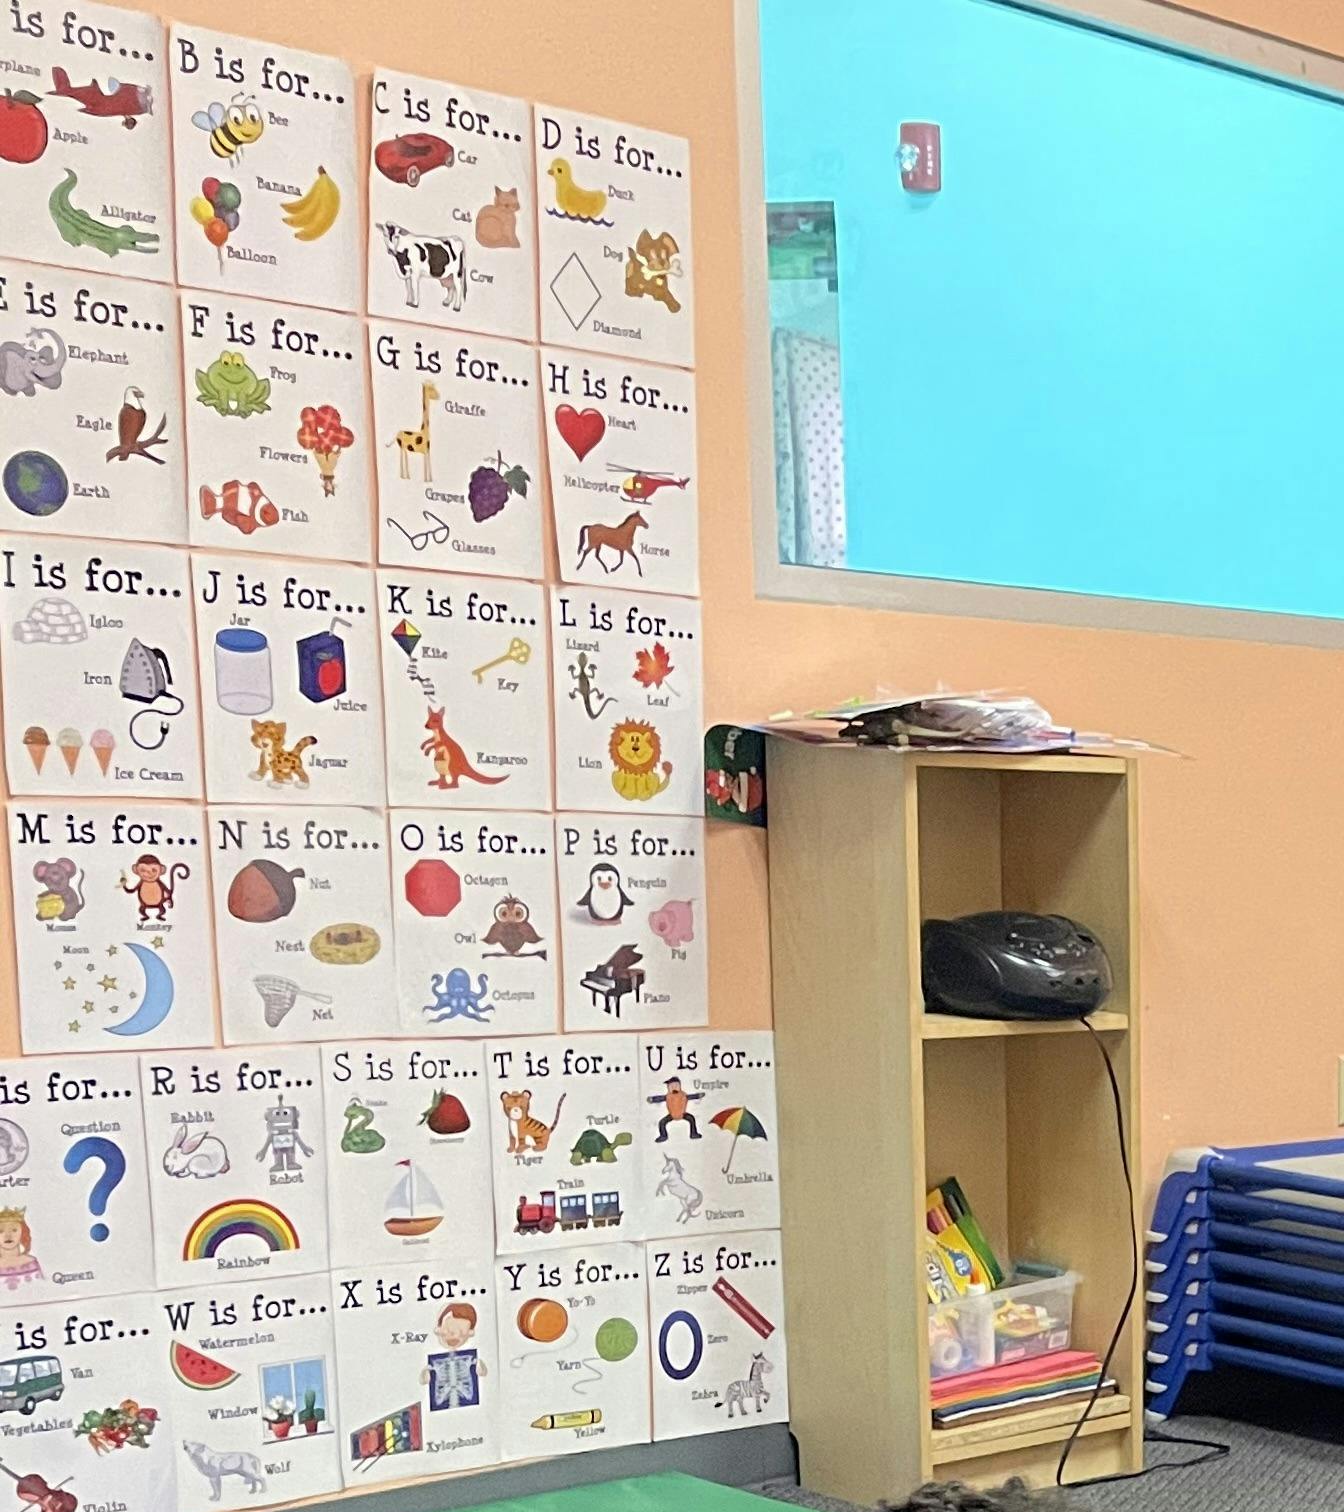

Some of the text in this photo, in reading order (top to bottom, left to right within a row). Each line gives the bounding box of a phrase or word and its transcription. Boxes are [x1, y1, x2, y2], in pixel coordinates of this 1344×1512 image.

[10, 0, 154, 61] is for...
[178, 38, 345, 104] B is for...
[375, 81, 522, 143] C is for...
[52, 128, 88, 144] Apple
[542, 117, 682, 178] D is for...
[101, 205, 156, 224] Alligator
[227, 246, 278, 265] Balloon
[24, 281, 56, 317] is
[74, 289, 164, 332] for...
[189, 304, 353, 360] F is for...
[68, 345, 129, 365] Elephant
[376, 335, 528, 387] G is for...
[270, 366, 296, 383] Frog
[549, 363, 689, 414] H is for...
[76, 416, 112, 432] Eagle
[260, 447, 308, 464] Flowers
[73, 483, 110, 499] Earth
[281, 509, 309, 523] Fish
[3, 551, 181, 598] I is for...
[202, 570, 366, 614] J is for...
[387, 585, 536, 626] K is for...
[229, 613, 250, 627] Jar
[559, 599, 694, 640] L is for...
[83, 672, 112, 686] Iron
[114, 767, 183, 782] Ice Cream
[16, 813, 197, 847] M is for...
[218, 819, 380, 851] N is for...
[400, 823, 546, 855] O is for...
[564, 828, 695, 857] P is for...
[454, 932, 476, 944] Owl
[332, 1051, 478, 1083] S is for...
[493, 1049, 631, 1080] T is for...
[645, 1045, 771, 1072] U is for...
[0, 1072, 131, 1106] is for...
[151, 1062, 312, 1096] R is for...
[586, 1114, 619, 1126] Turtle
[514, 1153, 543, 1166] Tiger
[557, 1178, 585, 1190] Train
[727, 1172, 774, 1185] Umbrella
[217, 1256, 270, 1270] Rainbow
[504, 1260, 639, 1292] Y is for...
[654, 1247, 777, 1278] Z is for...
[340, 1275, 486, 1310] X is for...
[164, 1294, 327, 1332] W is for...
[14, 1316, 149, 1352] is for...
[199, 1332, 274, 1349] Watermelon
[390, 1332, 428, 1345] X-Ray
[71, 1367, 94, 1379] Van
[556, 1360, 581, 1371] Yarn
[208, 1406, 258, 1420] Window
[1, 1418, 73, 1438] Vegetables
